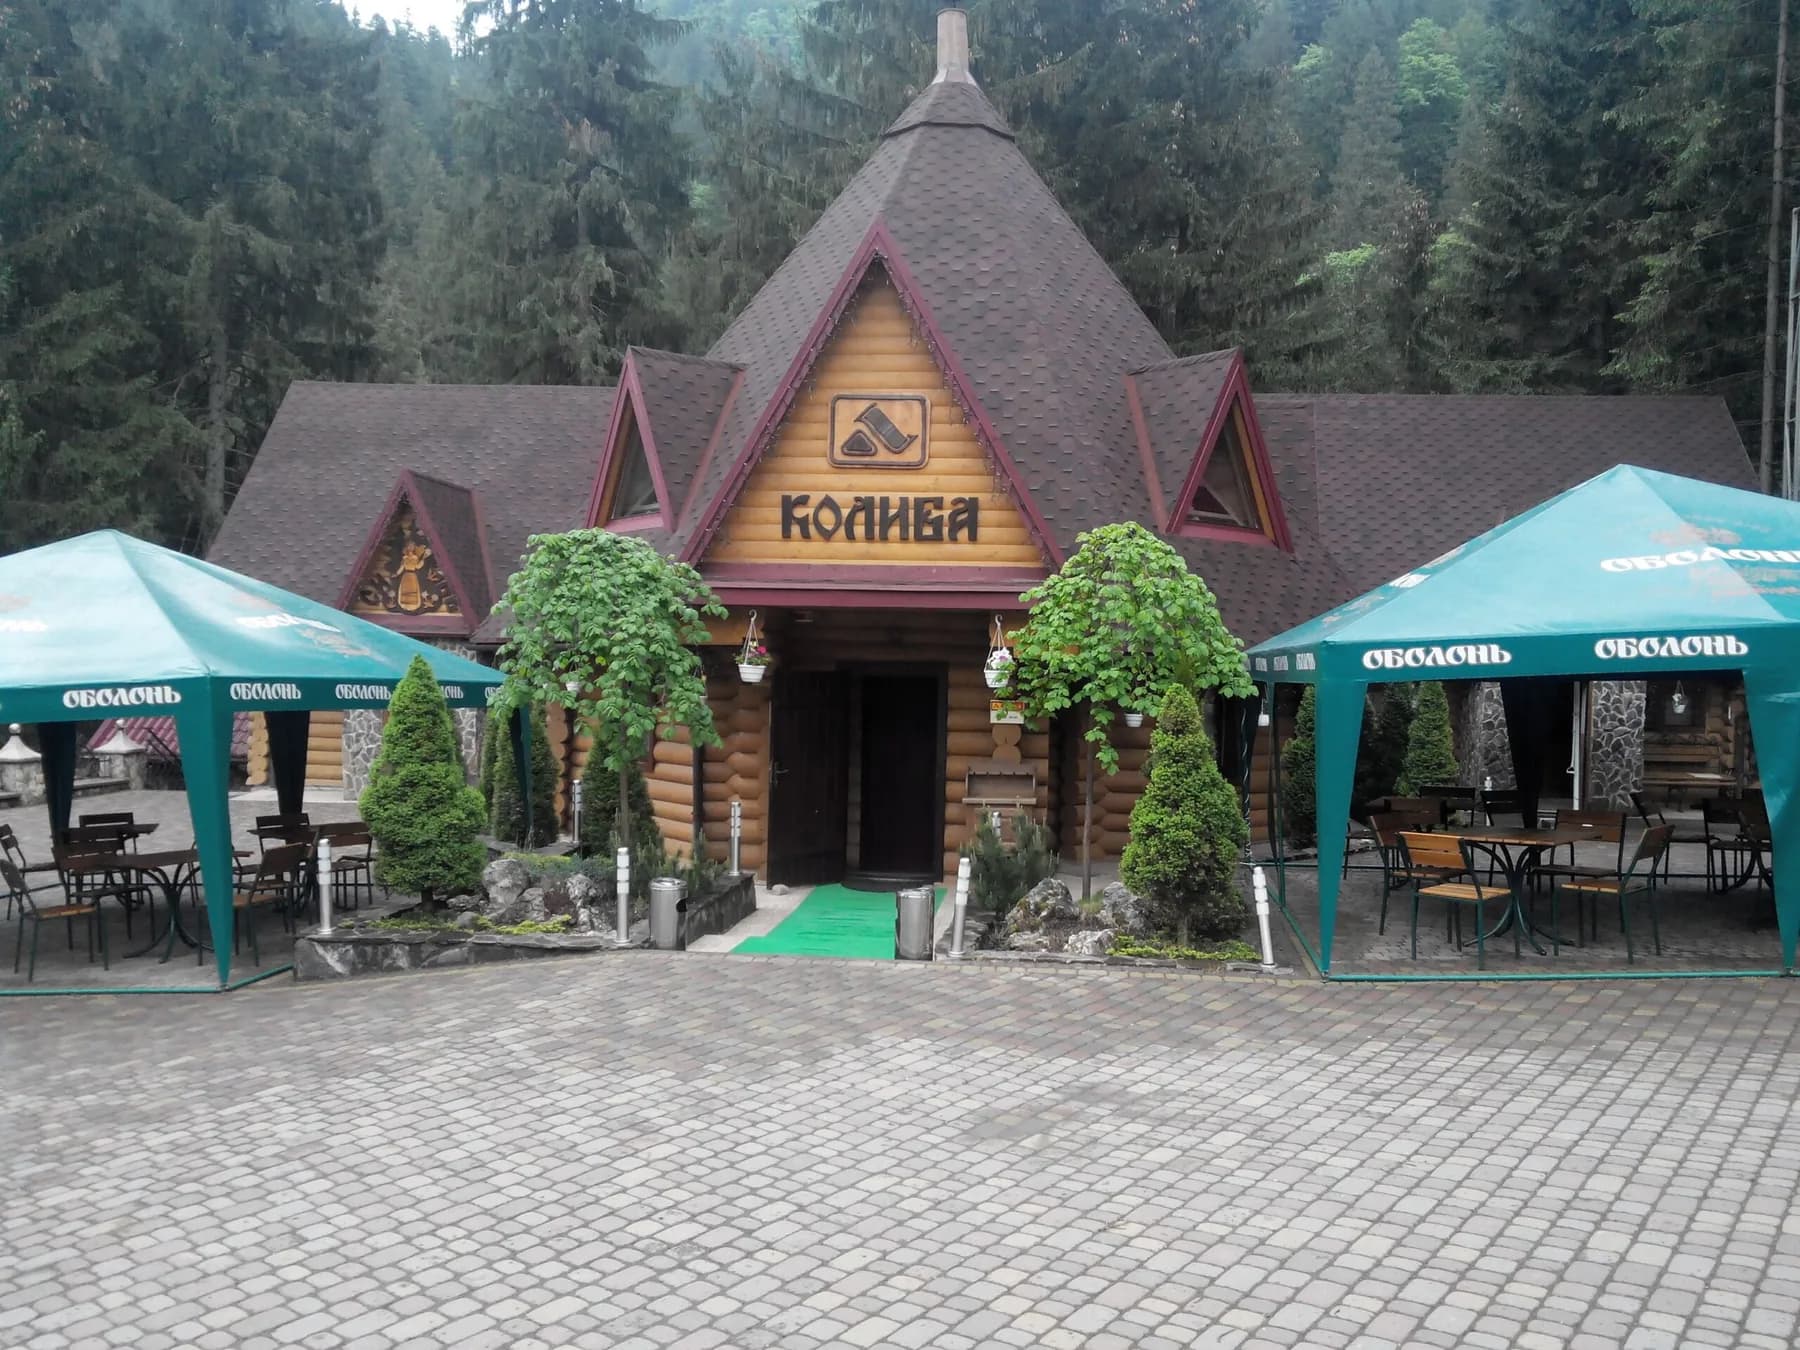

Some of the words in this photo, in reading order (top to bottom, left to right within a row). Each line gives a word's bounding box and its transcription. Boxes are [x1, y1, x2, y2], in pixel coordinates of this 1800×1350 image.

[781, 494, 979, 541] КОЛИБА
[1600, 547, 1800, 572] ОБОЛОН
[1363, 645, 1512, 669] ОБОЛОНЬ
[1595, 636, 1749, 659] ОБОЛОНЬ
[63, 686, 181, 708] ОБОЛОНЬ
[230, 683, 301, 700] ОБОЛОНЬ
[335, 684, 391, 700] ОБОЛОНЬ
